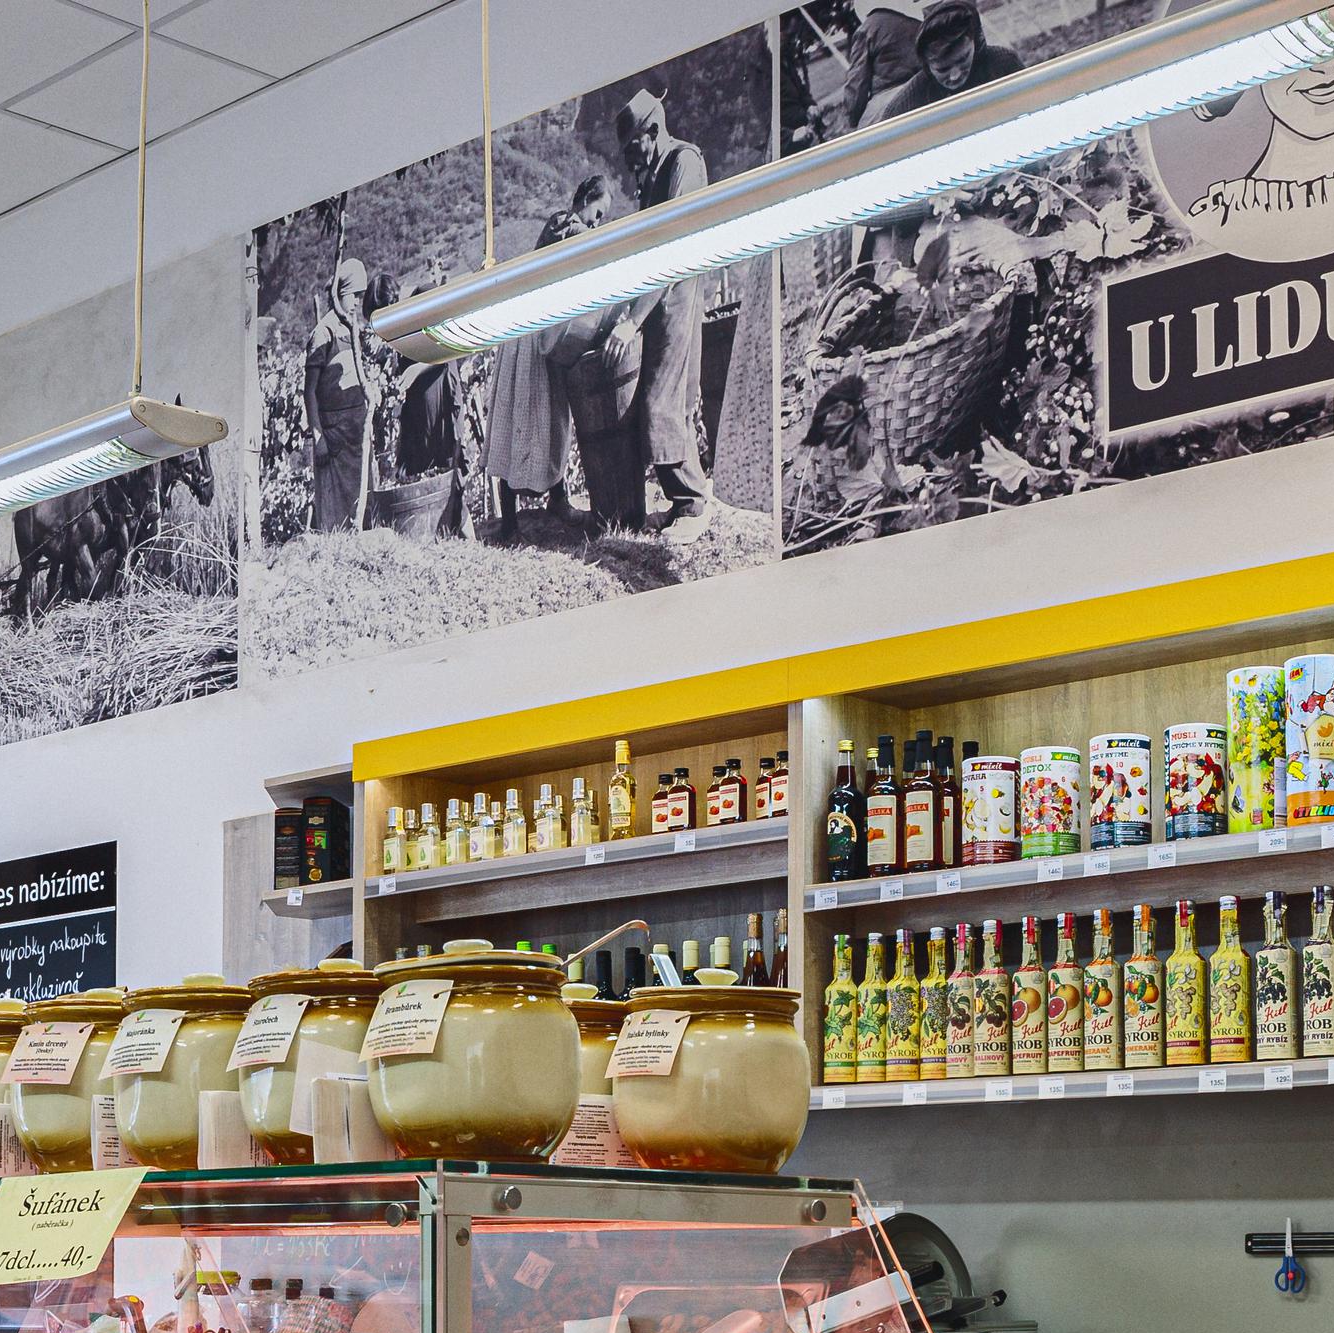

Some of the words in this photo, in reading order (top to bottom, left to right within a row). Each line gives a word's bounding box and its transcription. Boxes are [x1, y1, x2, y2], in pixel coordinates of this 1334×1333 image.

[1127, 315, 1173, 391] U
[1119, 740, 1140, 748] mixit
[1172, 732, 1196, 740] MUSLI
[981, 762, 1003, 770] mixit
[1022, 763, 1051, 775] DETOX
[19, 869, 105, 903] nabízíme:
[1, 936, 45, 977] výrobky
[1265, 1001, 1287, 1022] Kitl
[1310, 999, 1332, 1019] Kitl
[1021, 1021, 1043, 1038] Kitl
[1091, 1016, 1113, 1033] Kitl
[1138, 1013, 1159, 1030] Kitl
[1169, 1030, 1197, 1038] SYROB
[1213, 1028, 1242, 1036] SYROB
[19, 1188, 105, 1216] Šufánek
